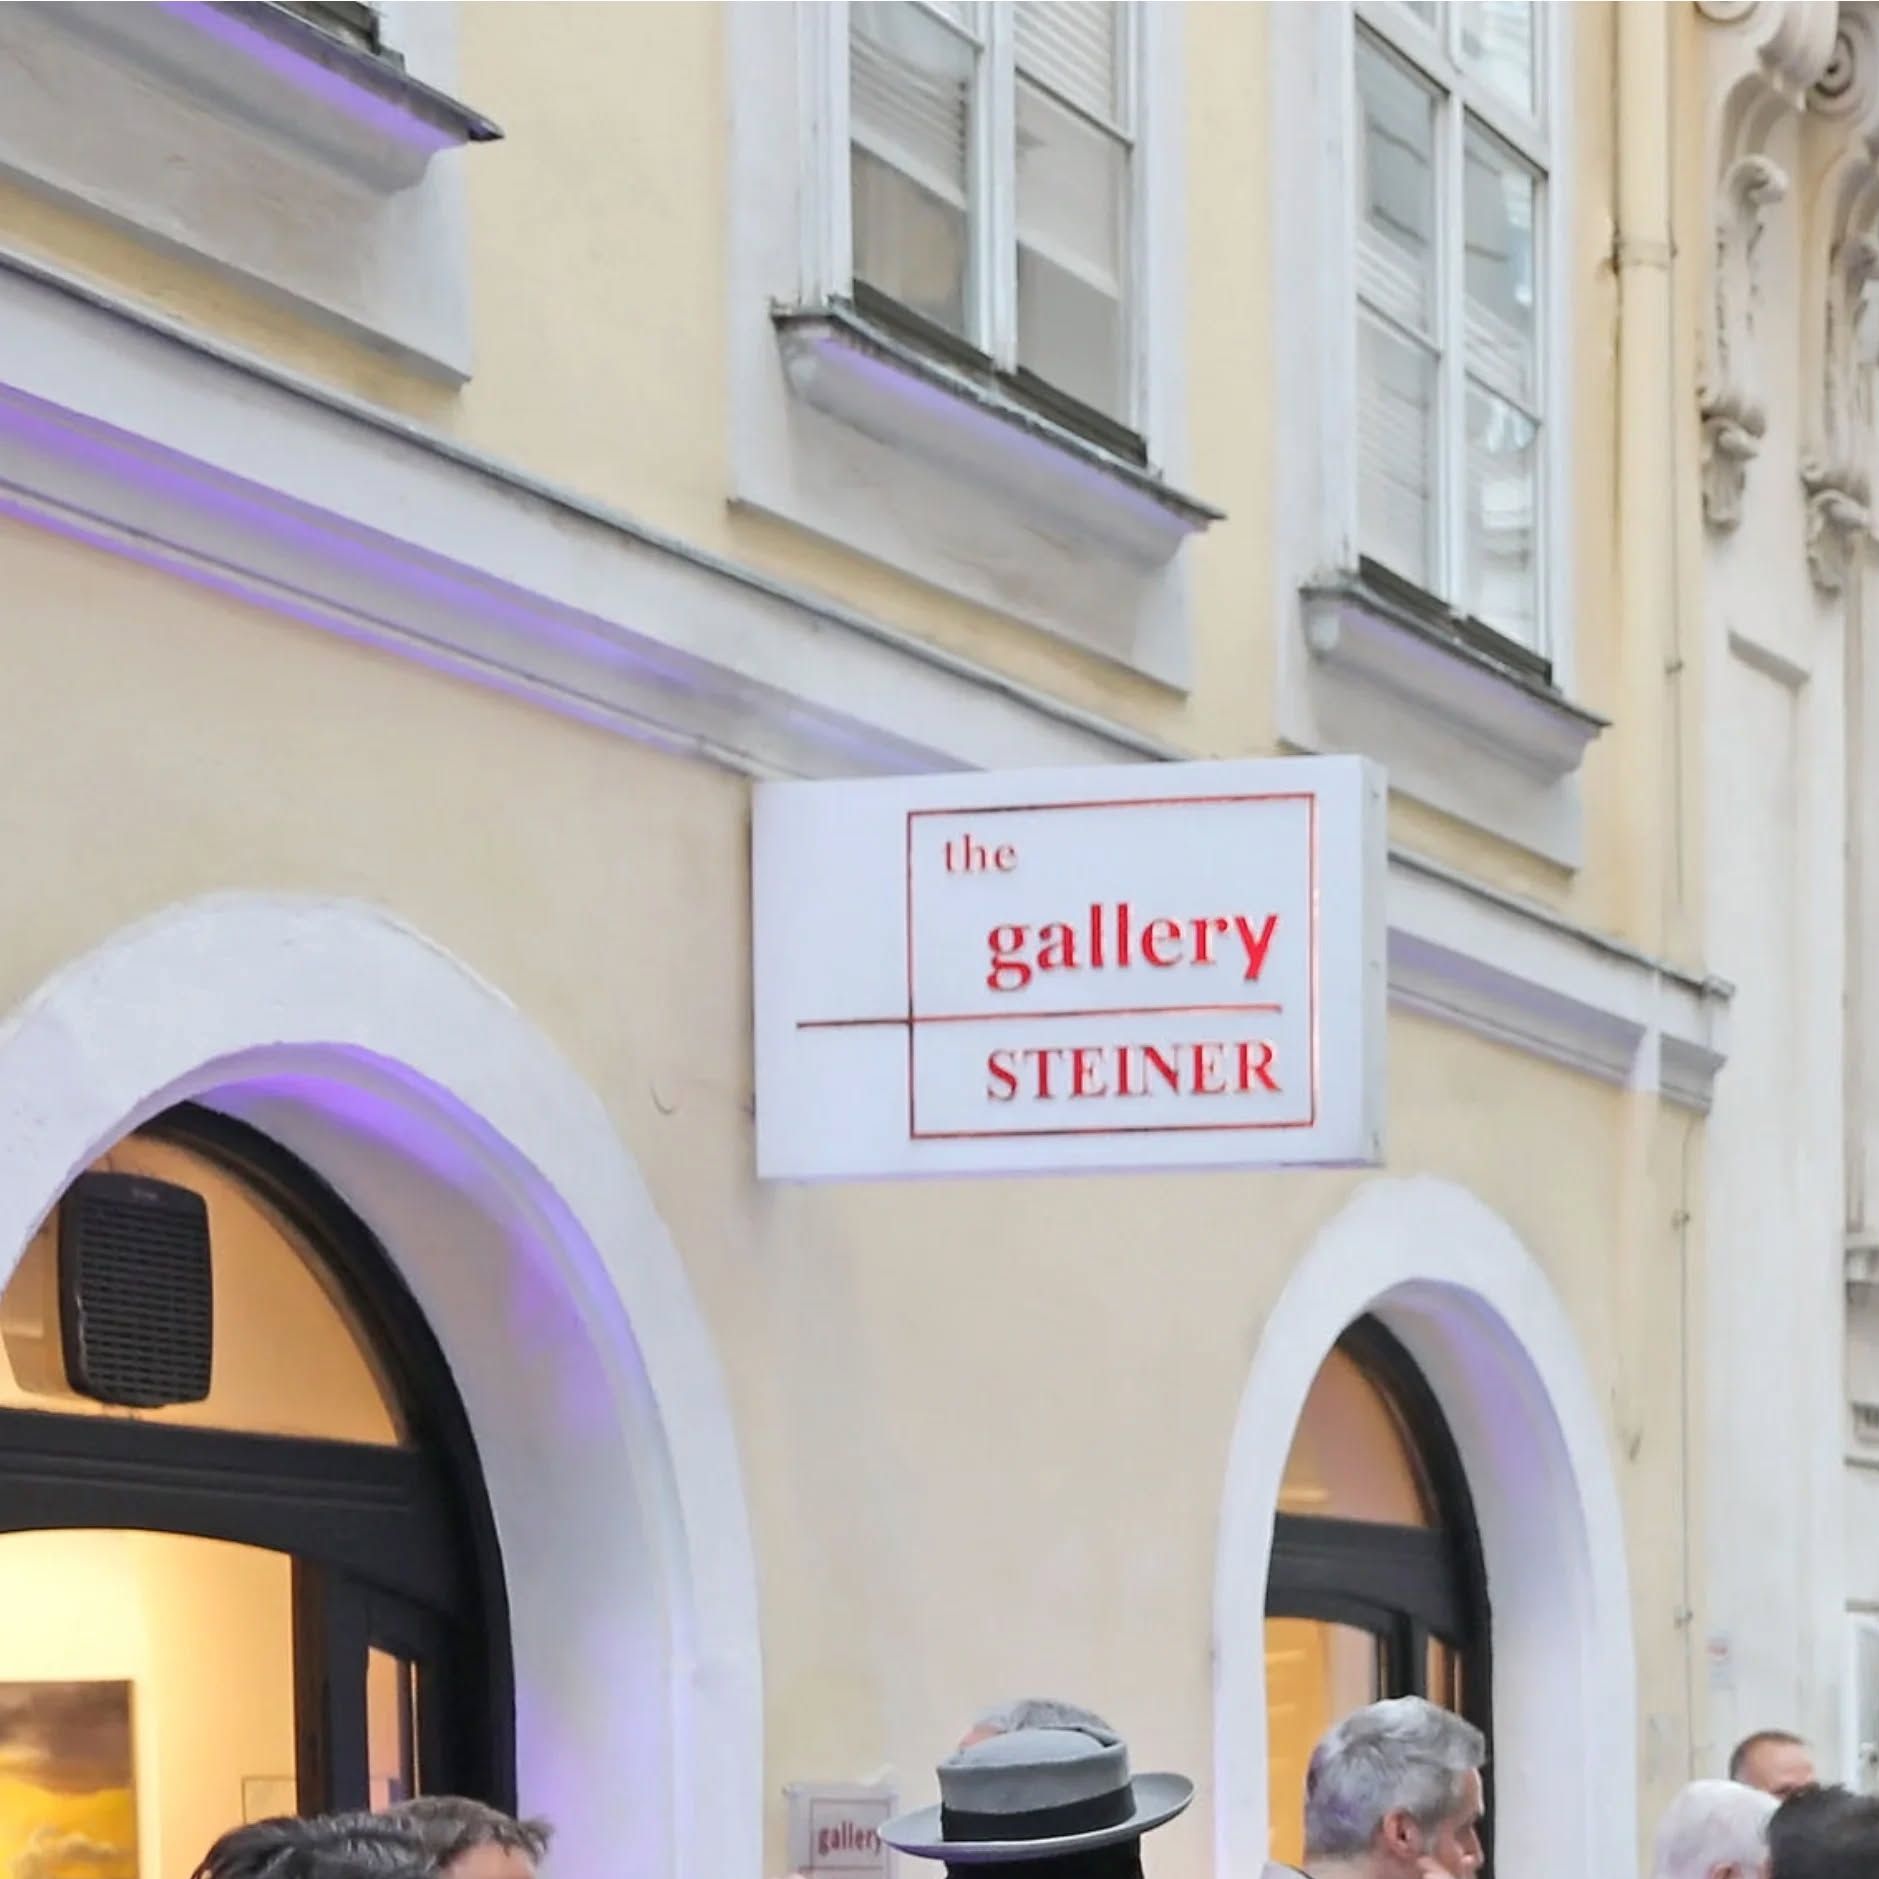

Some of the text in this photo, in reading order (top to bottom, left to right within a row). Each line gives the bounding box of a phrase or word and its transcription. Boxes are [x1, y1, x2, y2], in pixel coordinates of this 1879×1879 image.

[943, 832, 1017, 873] the
[986, 902, 1280, 992] gallery
[986, 1040, 1282, 1101] STEINER
